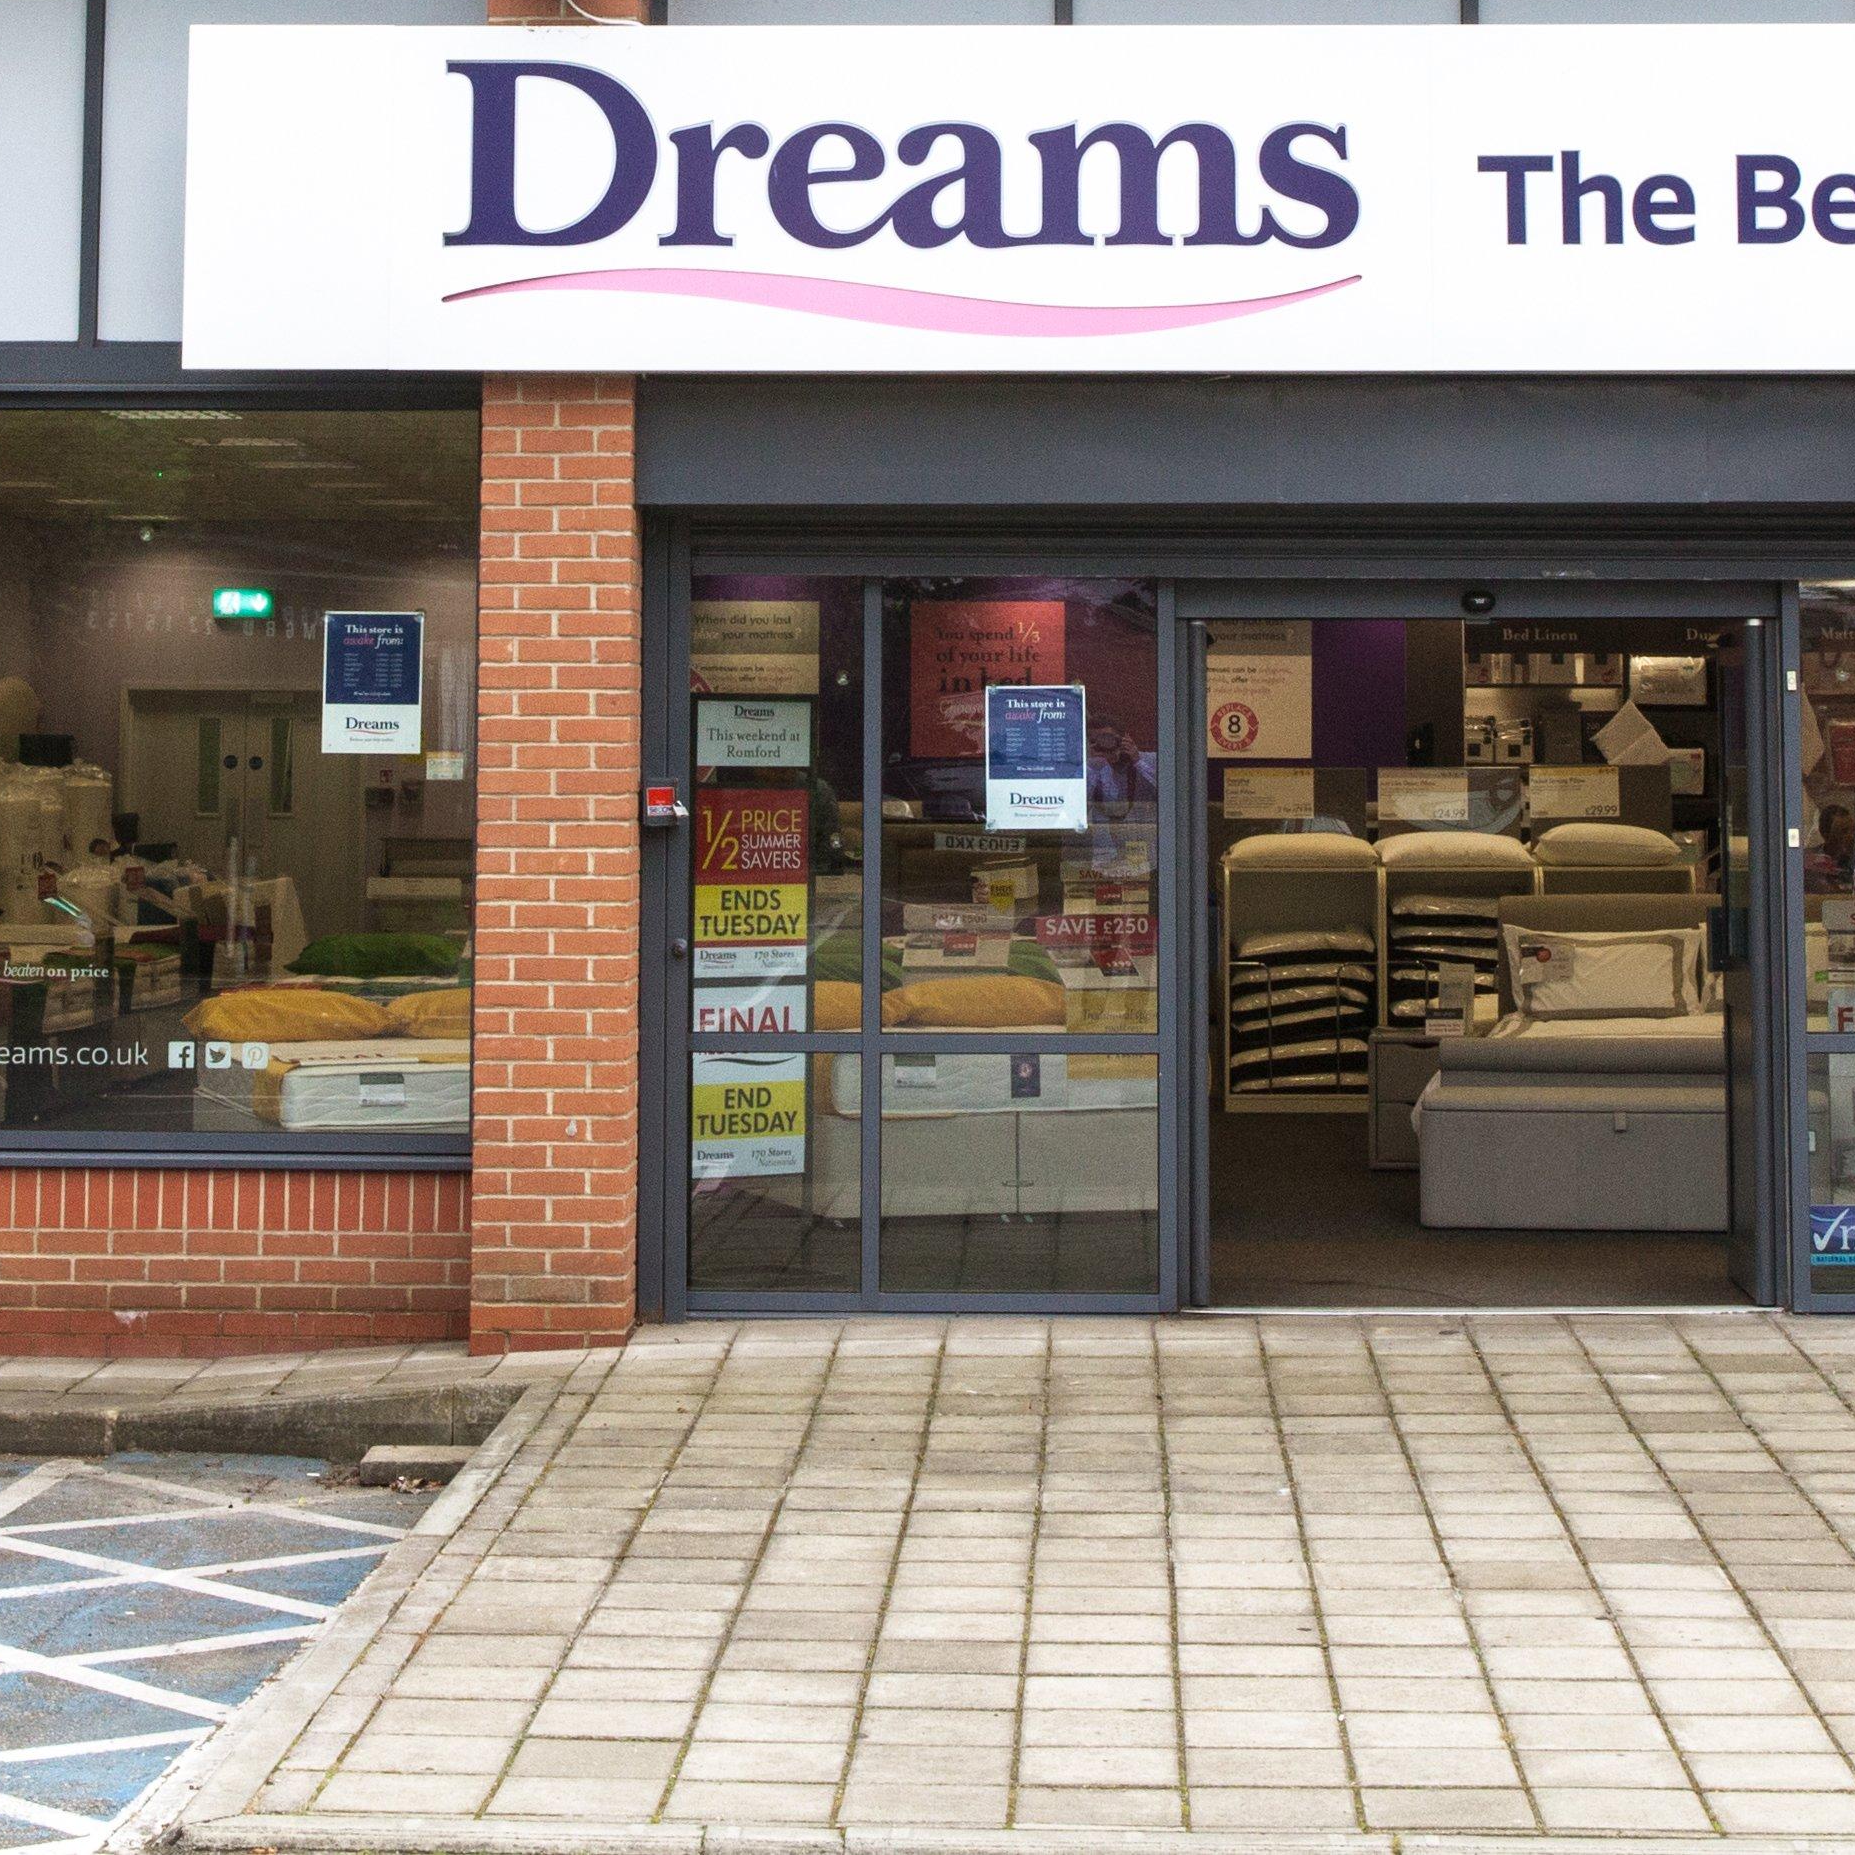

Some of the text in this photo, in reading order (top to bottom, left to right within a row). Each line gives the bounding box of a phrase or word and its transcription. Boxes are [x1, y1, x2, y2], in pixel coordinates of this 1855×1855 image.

[442, 58, 1363, 250] Dreams
[1476, 149, 1697, 245] The
[695, 613, 792, 627] When did you last
[345, 624, 404, 634] This store is
[722, 632, 745, 642] your
[969, 626, 1014, 645] spend
[1502, 628, 1578, 641] Bed Linen
[1686, 628, 1720, 642] Duv
[375, 635, 404, 649] from:
[936, 645, 1041, 665] of your life
[939, 667, 971, 692] in
[734, 704, 775, 717] Dreams
[1007, 698, 1066, 709] This store is
[345, 716, 400, 730] Dreams
[1036, 708, 1066, 724] from:
[1227, 714, 1241, 734] 8
[706, 727, 801, 742] This weekend at
[726, 745, 781, 758] Romford
[1009, 792, 1065, 805] Dreams
[1585, 805, 1618, 815] £29.99
[741, 809, 802, 833] PRICE
[741, 833, 801, 849] SUMMER
[741, 850, 801, 869] SAVERS
[720, 889, 781, 911] ENDS
[699, 913, 801, 937] TUESDAY
[1045, 918, 1149, 936] SAVE £250
[699, 950, 737, 961] Dreams
[3, 962, 45, 978] beaten
[47, 966, 67, 978] on
[71, 962, 110, 981] price
[699, 1005, 797, 1033] FINAL
[724, 1087, 773, 1110] END
[697, 1110, 797, 1136] TUESDAY
[697, 1150, 735, 1160] Dreams
